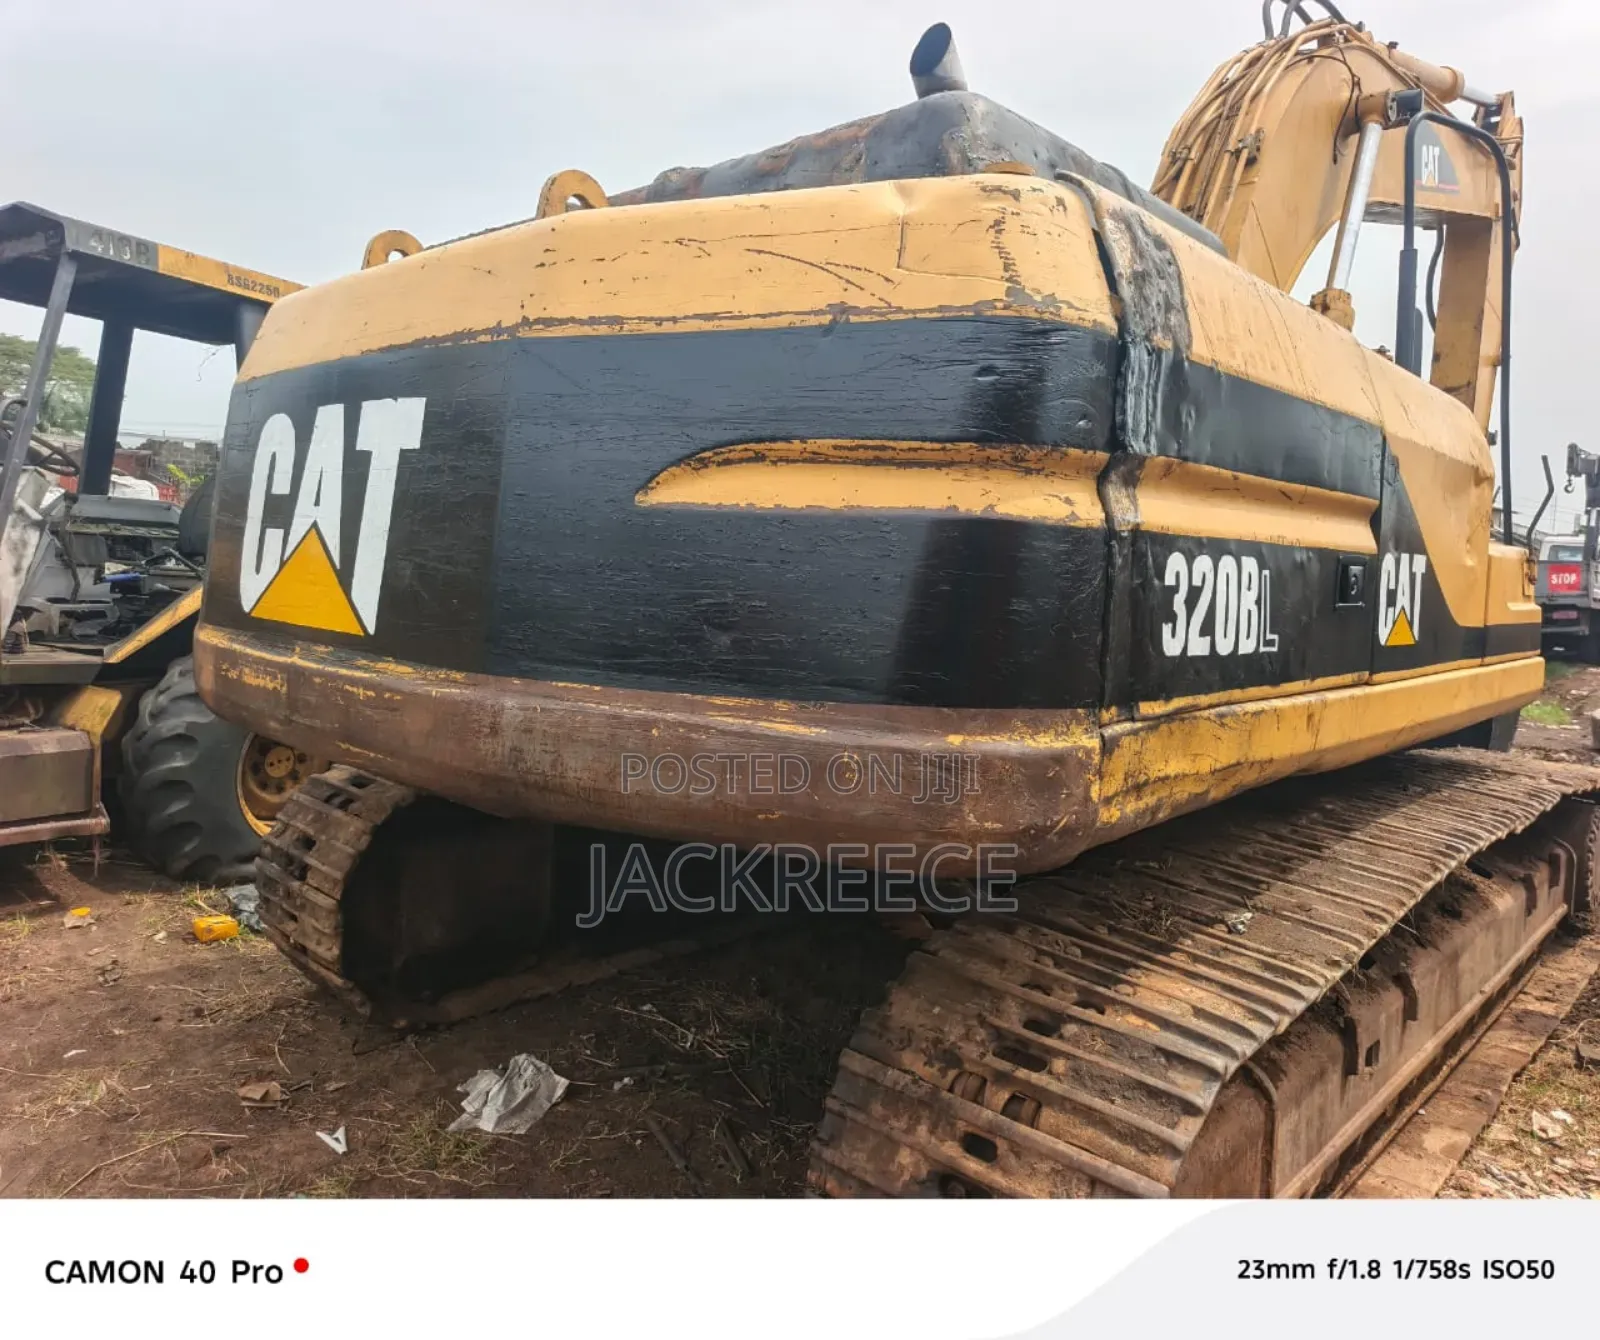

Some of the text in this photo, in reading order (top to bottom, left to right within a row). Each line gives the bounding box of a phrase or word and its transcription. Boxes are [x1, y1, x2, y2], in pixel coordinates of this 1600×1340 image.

[1421, 144, 1440, 185] CAT
[239, 397, 427, 636] CAT
[1378, 552, 1427, 646] CAT
[1550, 573, 1578, 585] STOP
